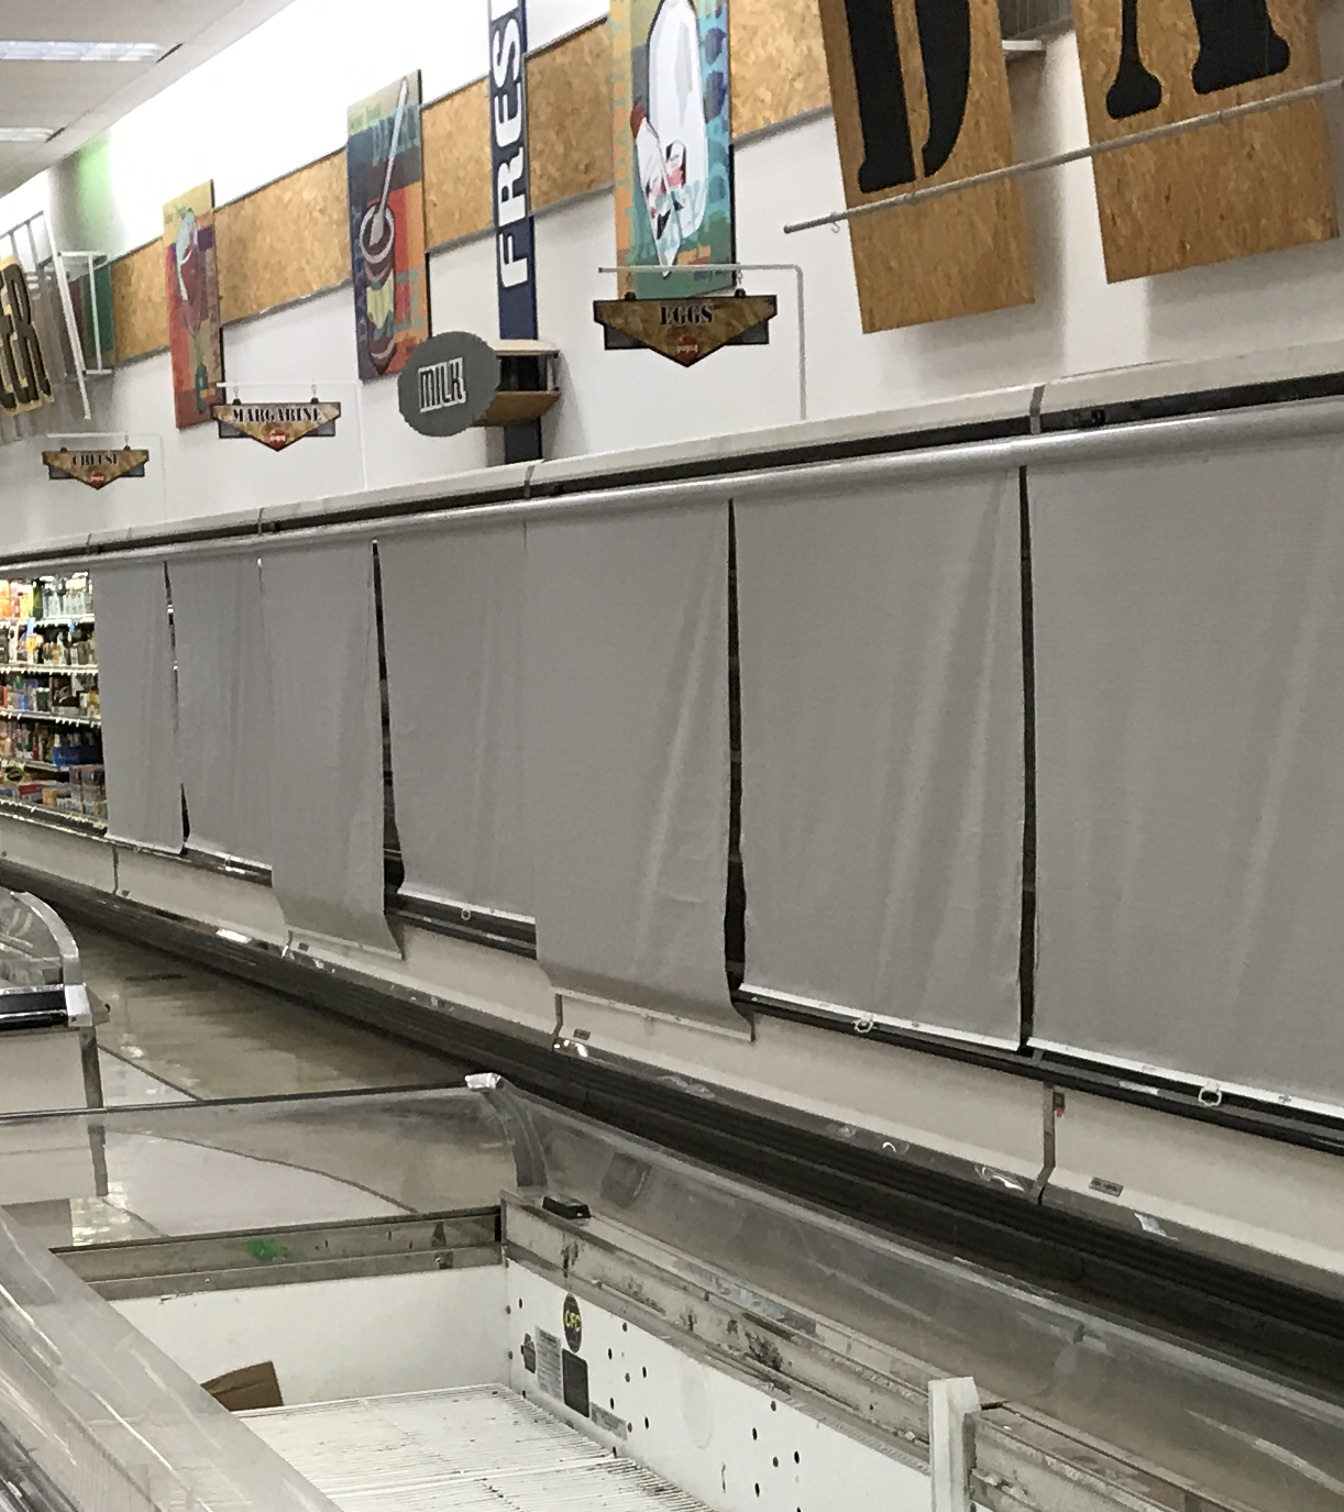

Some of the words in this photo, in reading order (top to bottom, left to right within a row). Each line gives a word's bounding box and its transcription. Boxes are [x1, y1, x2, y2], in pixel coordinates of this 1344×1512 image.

[660, 304, 714, 325] EGGS
[418, 357, 466, 413] MILK
[233, 407, 320, 422] MARGARINE
[564, 1309, 581, 1333] CFC
